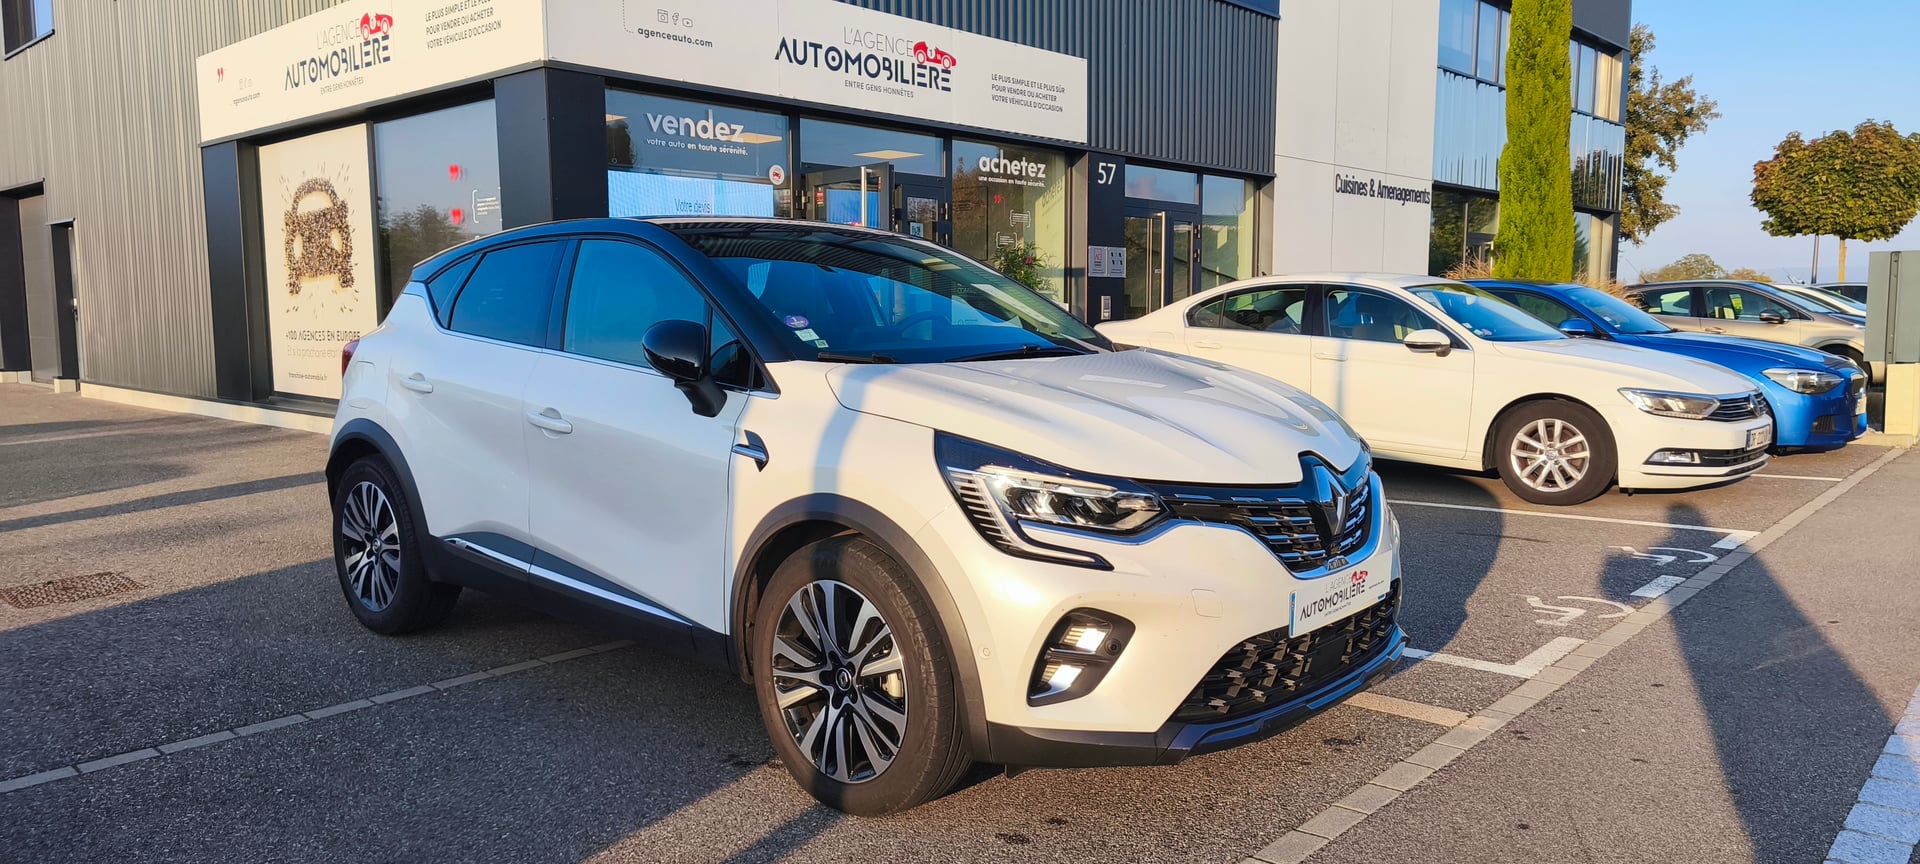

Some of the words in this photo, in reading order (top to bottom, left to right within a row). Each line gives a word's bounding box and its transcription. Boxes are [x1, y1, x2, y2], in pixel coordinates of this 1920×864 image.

[425, 12, 432, 22] LE
[432, 8, 444, 20] PLUS
[445, 2, 463, 16] SIMPLE
[426, 24, 440, 35] POUR
[441, 17, 460, 31] VENDRE
[461, 14, 469, 25] OU
[470, 7, 494, 22] ACHETER
[317, 18, 360, 50] L'AGENCE
[427, 37, 442, 49] VOTRE
[638, 28, 713, 48] agenceauto.com
[844, 26, 914, 58] L'AGENCE
[844, 79, 865, 90] ENTRE
[866, 83, 882, 94] GENS
[992, 84, 1006, 93] POUR
[1007, 86, 1026, 96] VENDRE
[1035, 92, 1057, 102] ACHETER
[998, 74, 1011, 83] PLUS
[1012, 77, 1030, 88] SIMPLE
[1043, 83, 1055, 92] PLUS
[992, 94, 1008, 104] VOTRE
[1033, 101, 1063, 112] D'OCCASION
[646, 109, 744, 143] vendez
[646, 138, 666, 147] votre
[668, 140, 686, 149] auto
[698, 143, 717, 152] toute
[719, 144, 748, 156] sérénité.
[979, 149, 1046, 178] achetez
[1098, 162, 1116, 184] 57
[1335, 173, 1368, 197] Cuisines
[1369, 178, 1375, 197] &
[1377, 180, 1430, 206] Amenagements
[674, 198, 692, 212] Votre
[286, 330, 297, 340] +100
[298, 330, 325, 341] AGENCES
[327, 330, 335, 341] EN
[336, 330, 360, 342] EUROPE
